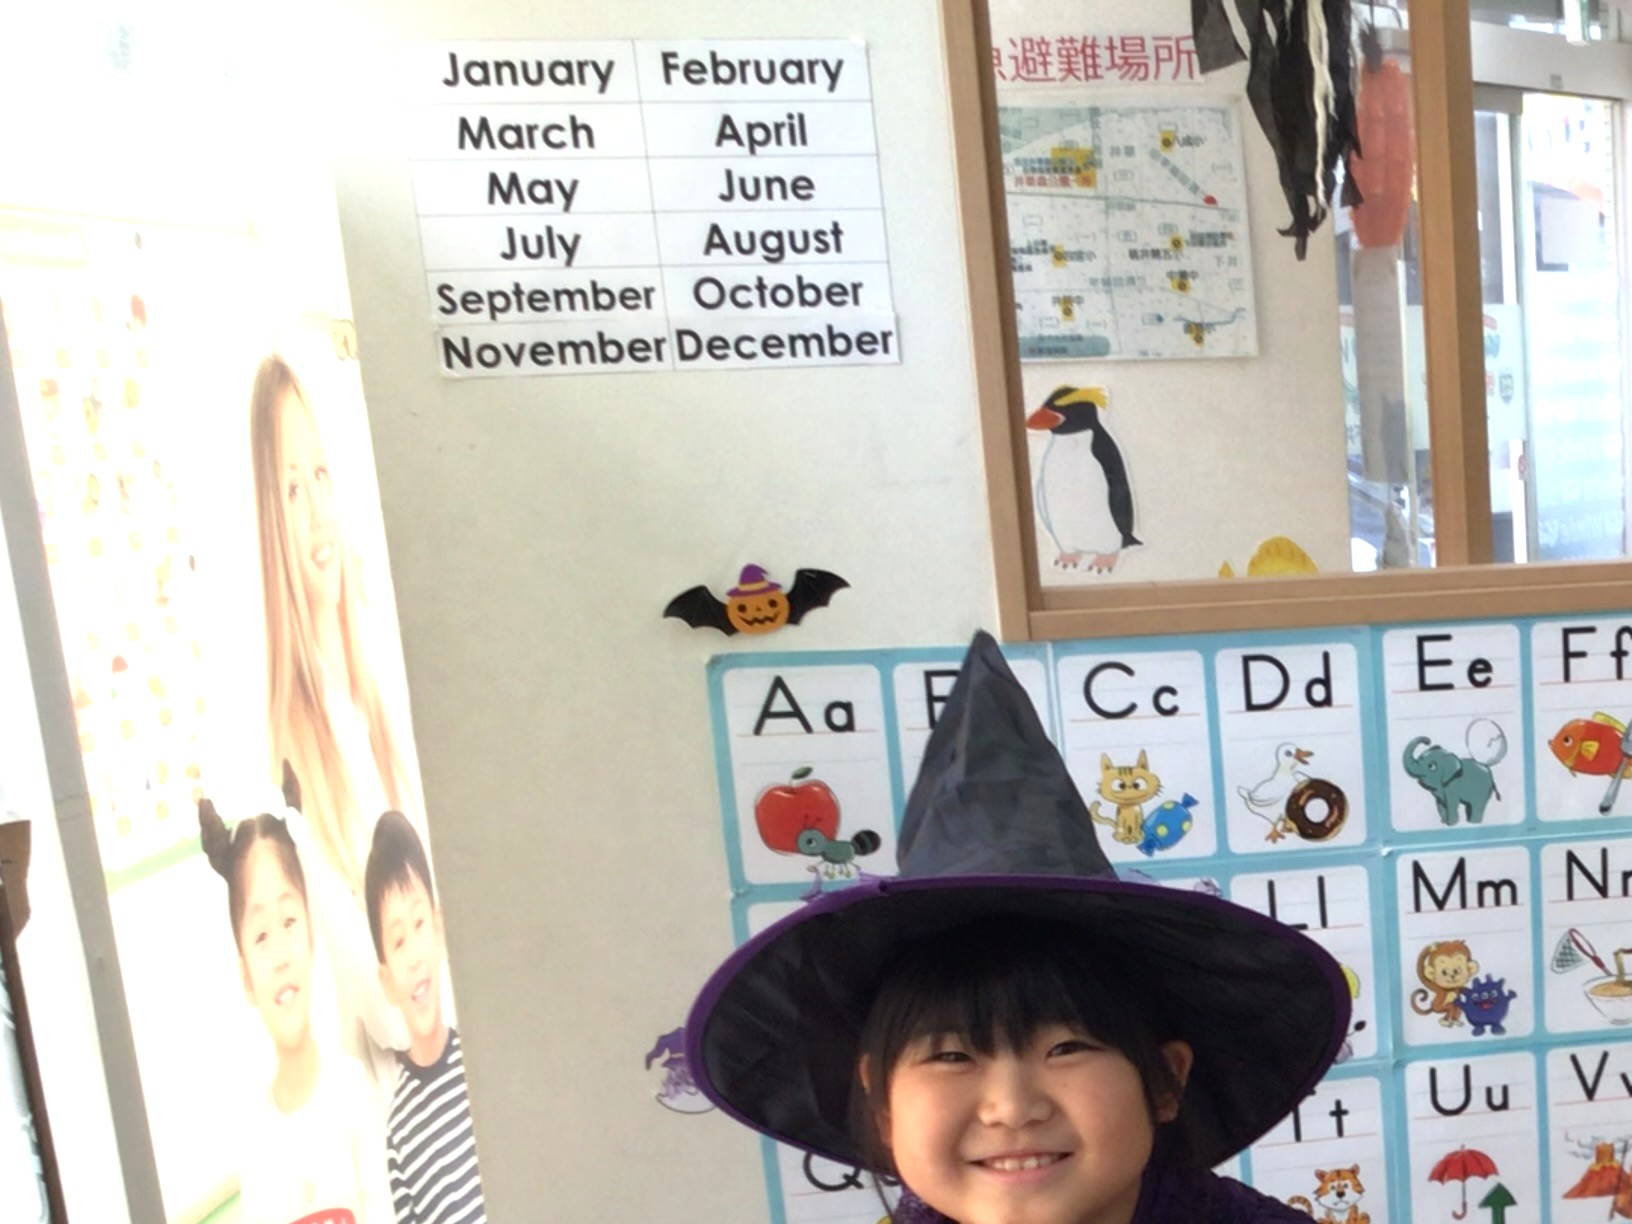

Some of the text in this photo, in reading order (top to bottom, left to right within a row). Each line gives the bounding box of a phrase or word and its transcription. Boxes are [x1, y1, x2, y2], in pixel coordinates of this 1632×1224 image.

[443, 53, 614, 94] January
[661, 51, 844, 92] February
[458, 115, 595, 150] March
[715, 113, 808, 156] April
[487, 172, 579, 213] May
[718, 169, 816, 202] June
[500, 225, 581, 267] July
[704, 221, 844, 264] August
[437, 279, 656, 321] September
[692, 275, 863, 310] October
[442, 331, 666, 369] November
[675, 324, 892, 361] December
[753, 675, 856, 736] Aa
[1083, 662, 1180, 719] Cc
[1242, 651, 1333, 712] Dd
[1415, 634, 1493, 691] Ee
[1413, 857, 1518, 913] Mm
[1430, 1064, 1510, 1116] Uu
